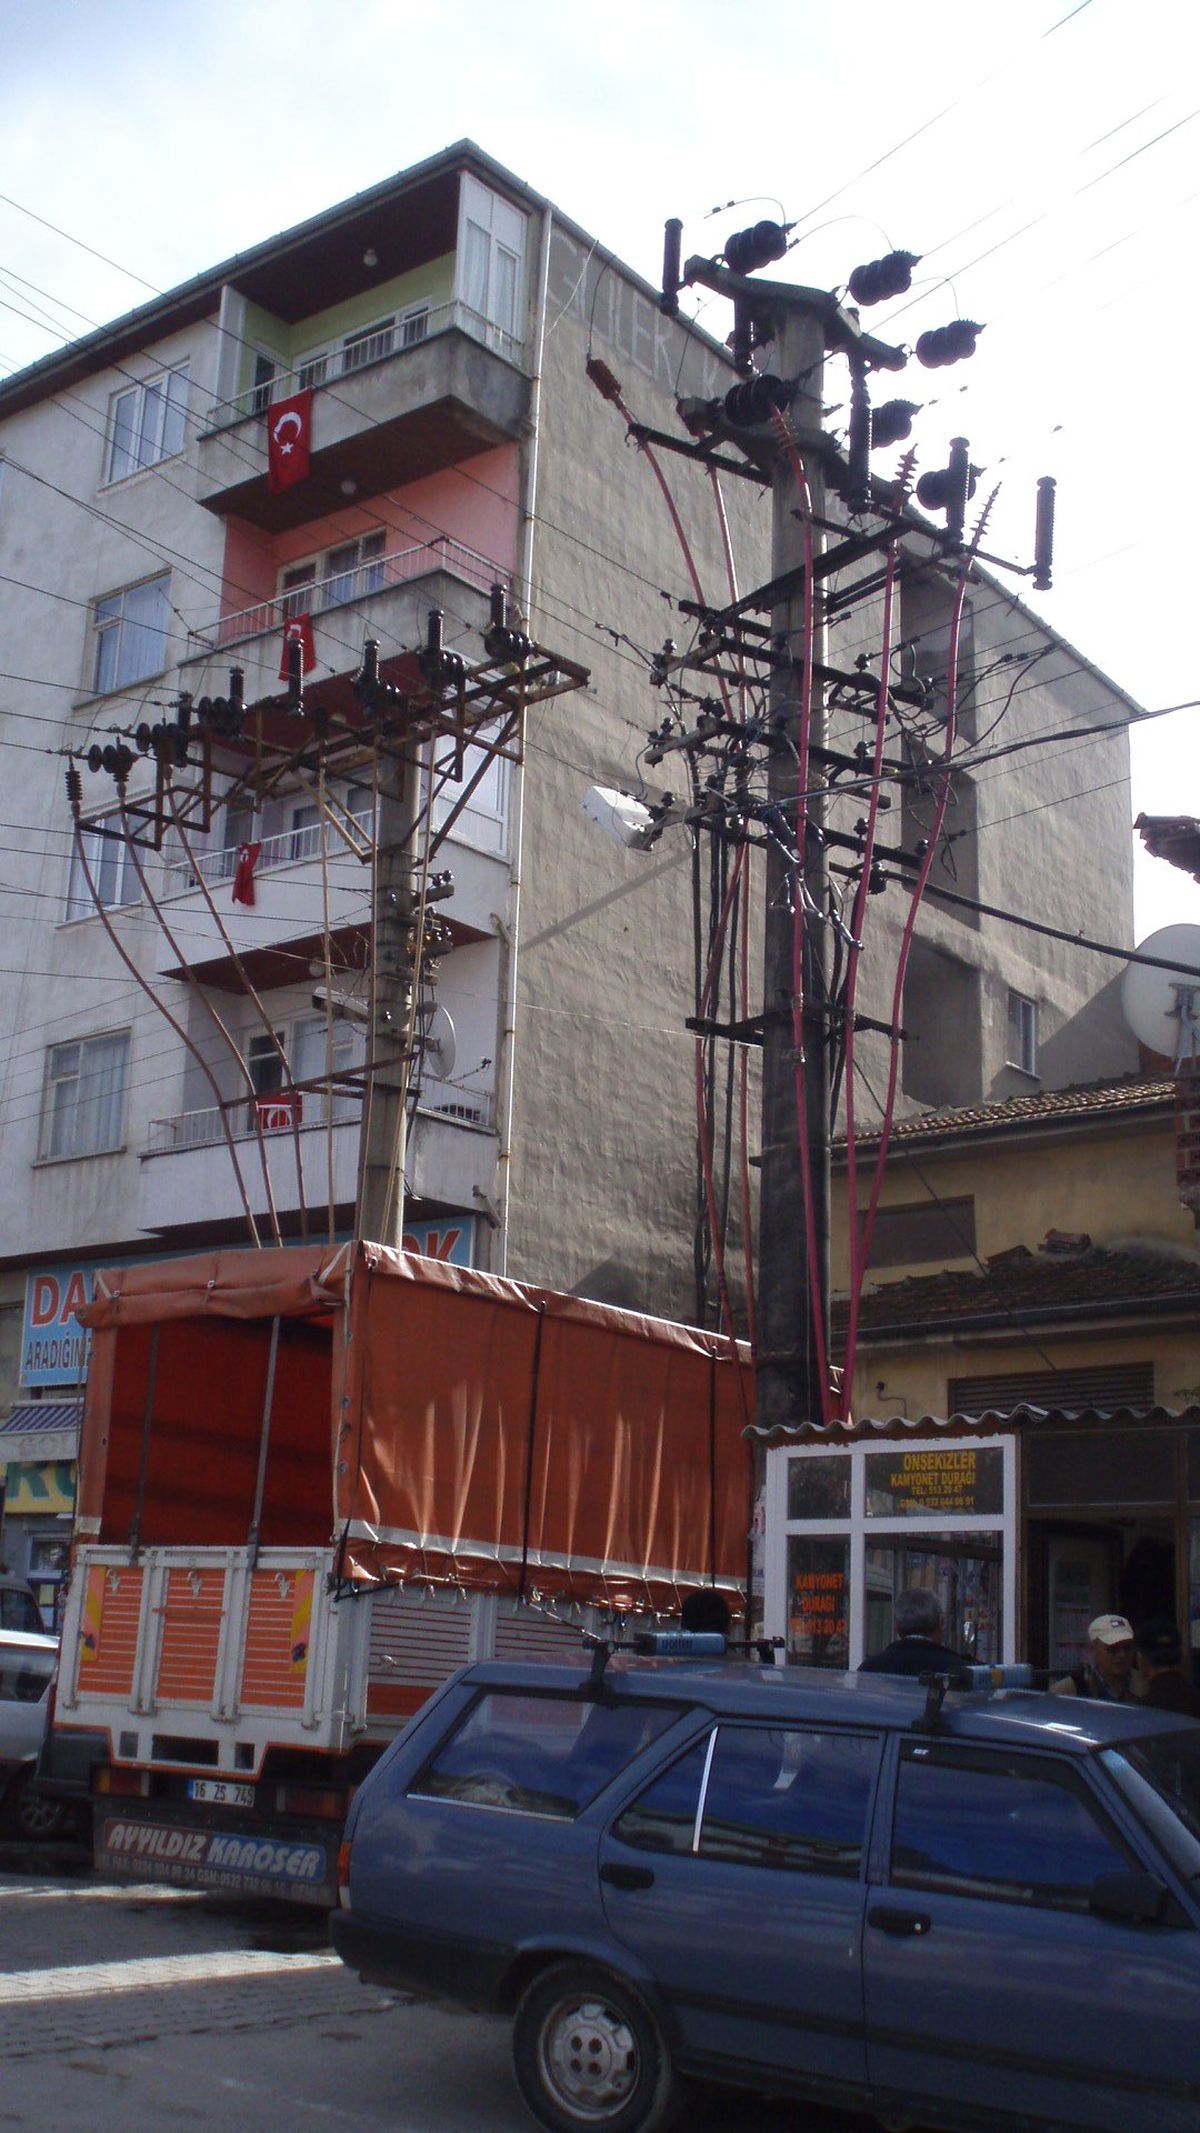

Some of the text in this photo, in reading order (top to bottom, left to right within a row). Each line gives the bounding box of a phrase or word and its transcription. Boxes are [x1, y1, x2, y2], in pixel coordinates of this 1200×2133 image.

[891, 1473, 939, 1487] KAMYONET
[195, 1781, 206, 1798] 16
[207, 1837, 320, 1877] KAROSER
